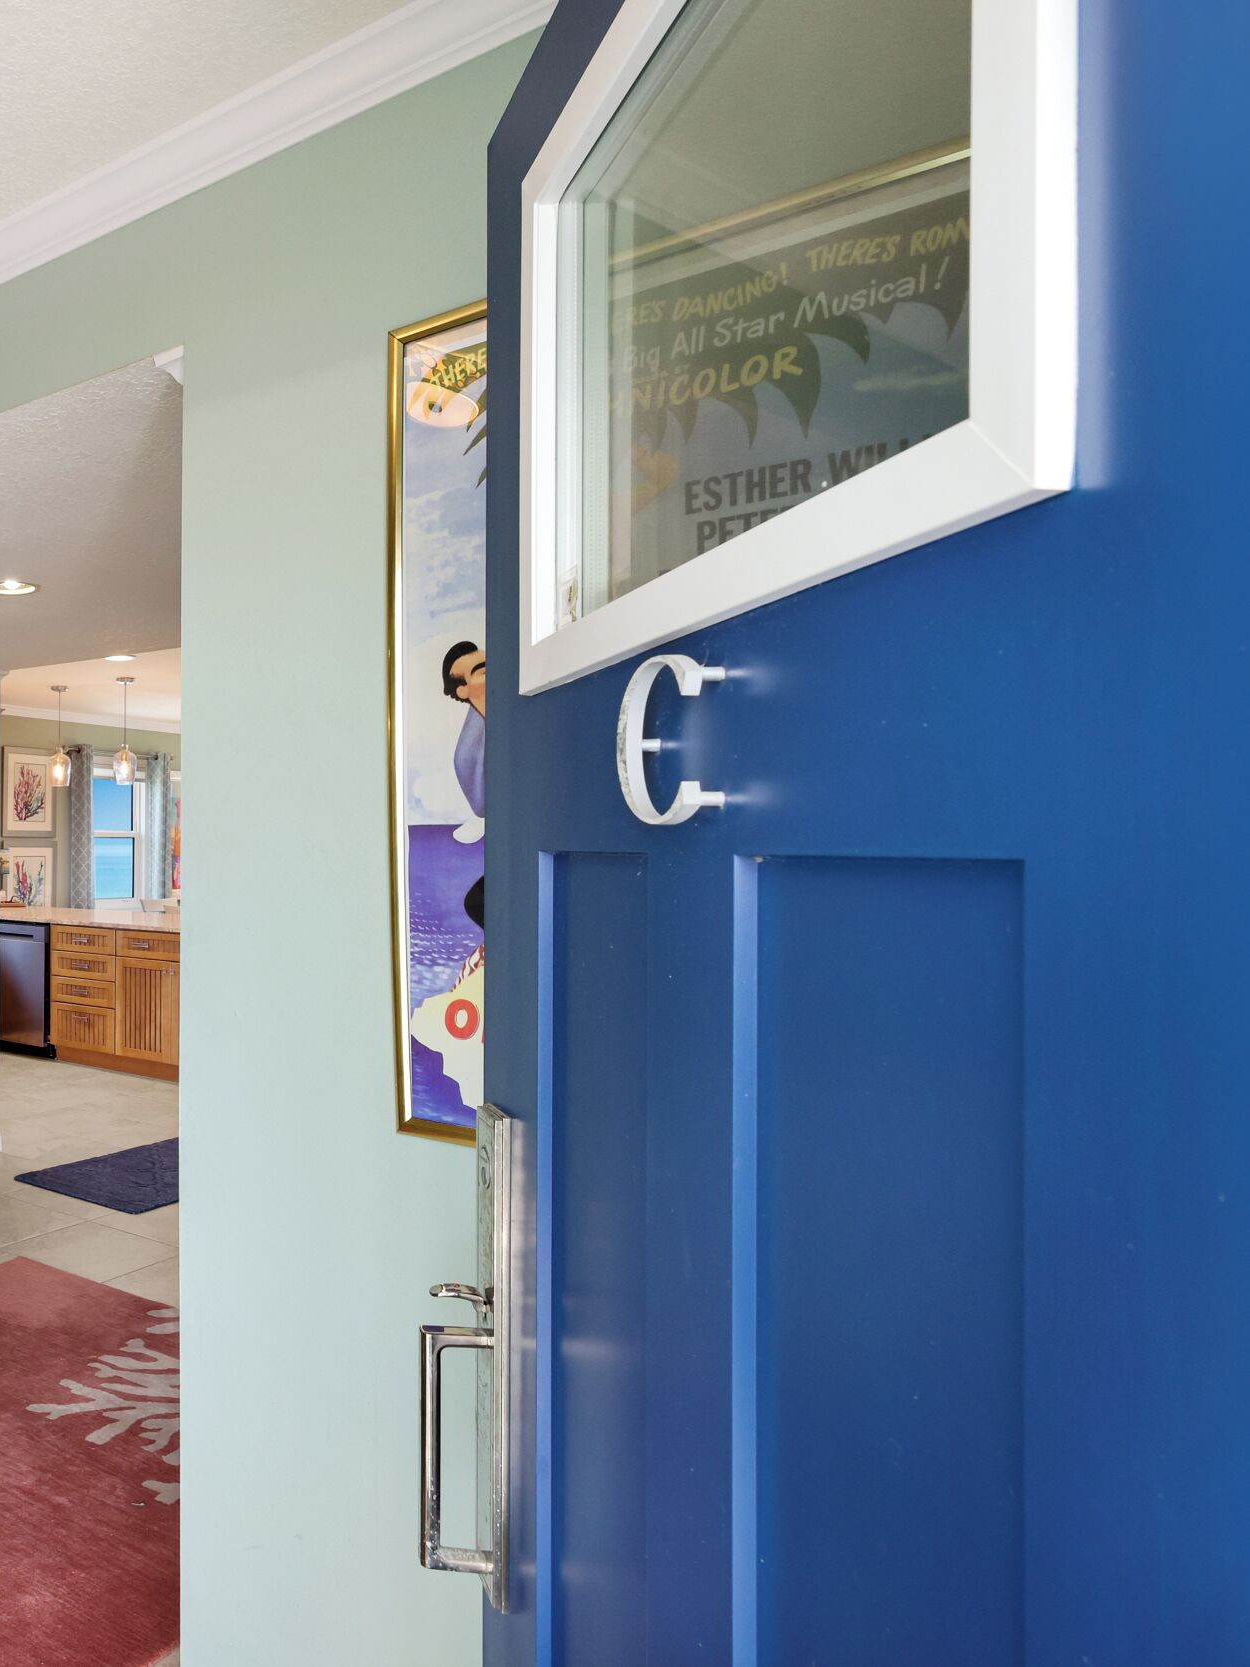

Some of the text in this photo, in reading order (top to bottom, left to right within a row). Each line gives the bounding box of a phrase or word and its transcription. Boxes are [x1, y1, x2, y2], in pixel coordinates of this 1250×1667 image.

[672, 262, 787, 322] DANCING!
[670, 325, 705, 360] All
[713, 311, 785, 348] Star
[684, 458, 812, 515] ESTHER
[617, 654, 706, 825] C
